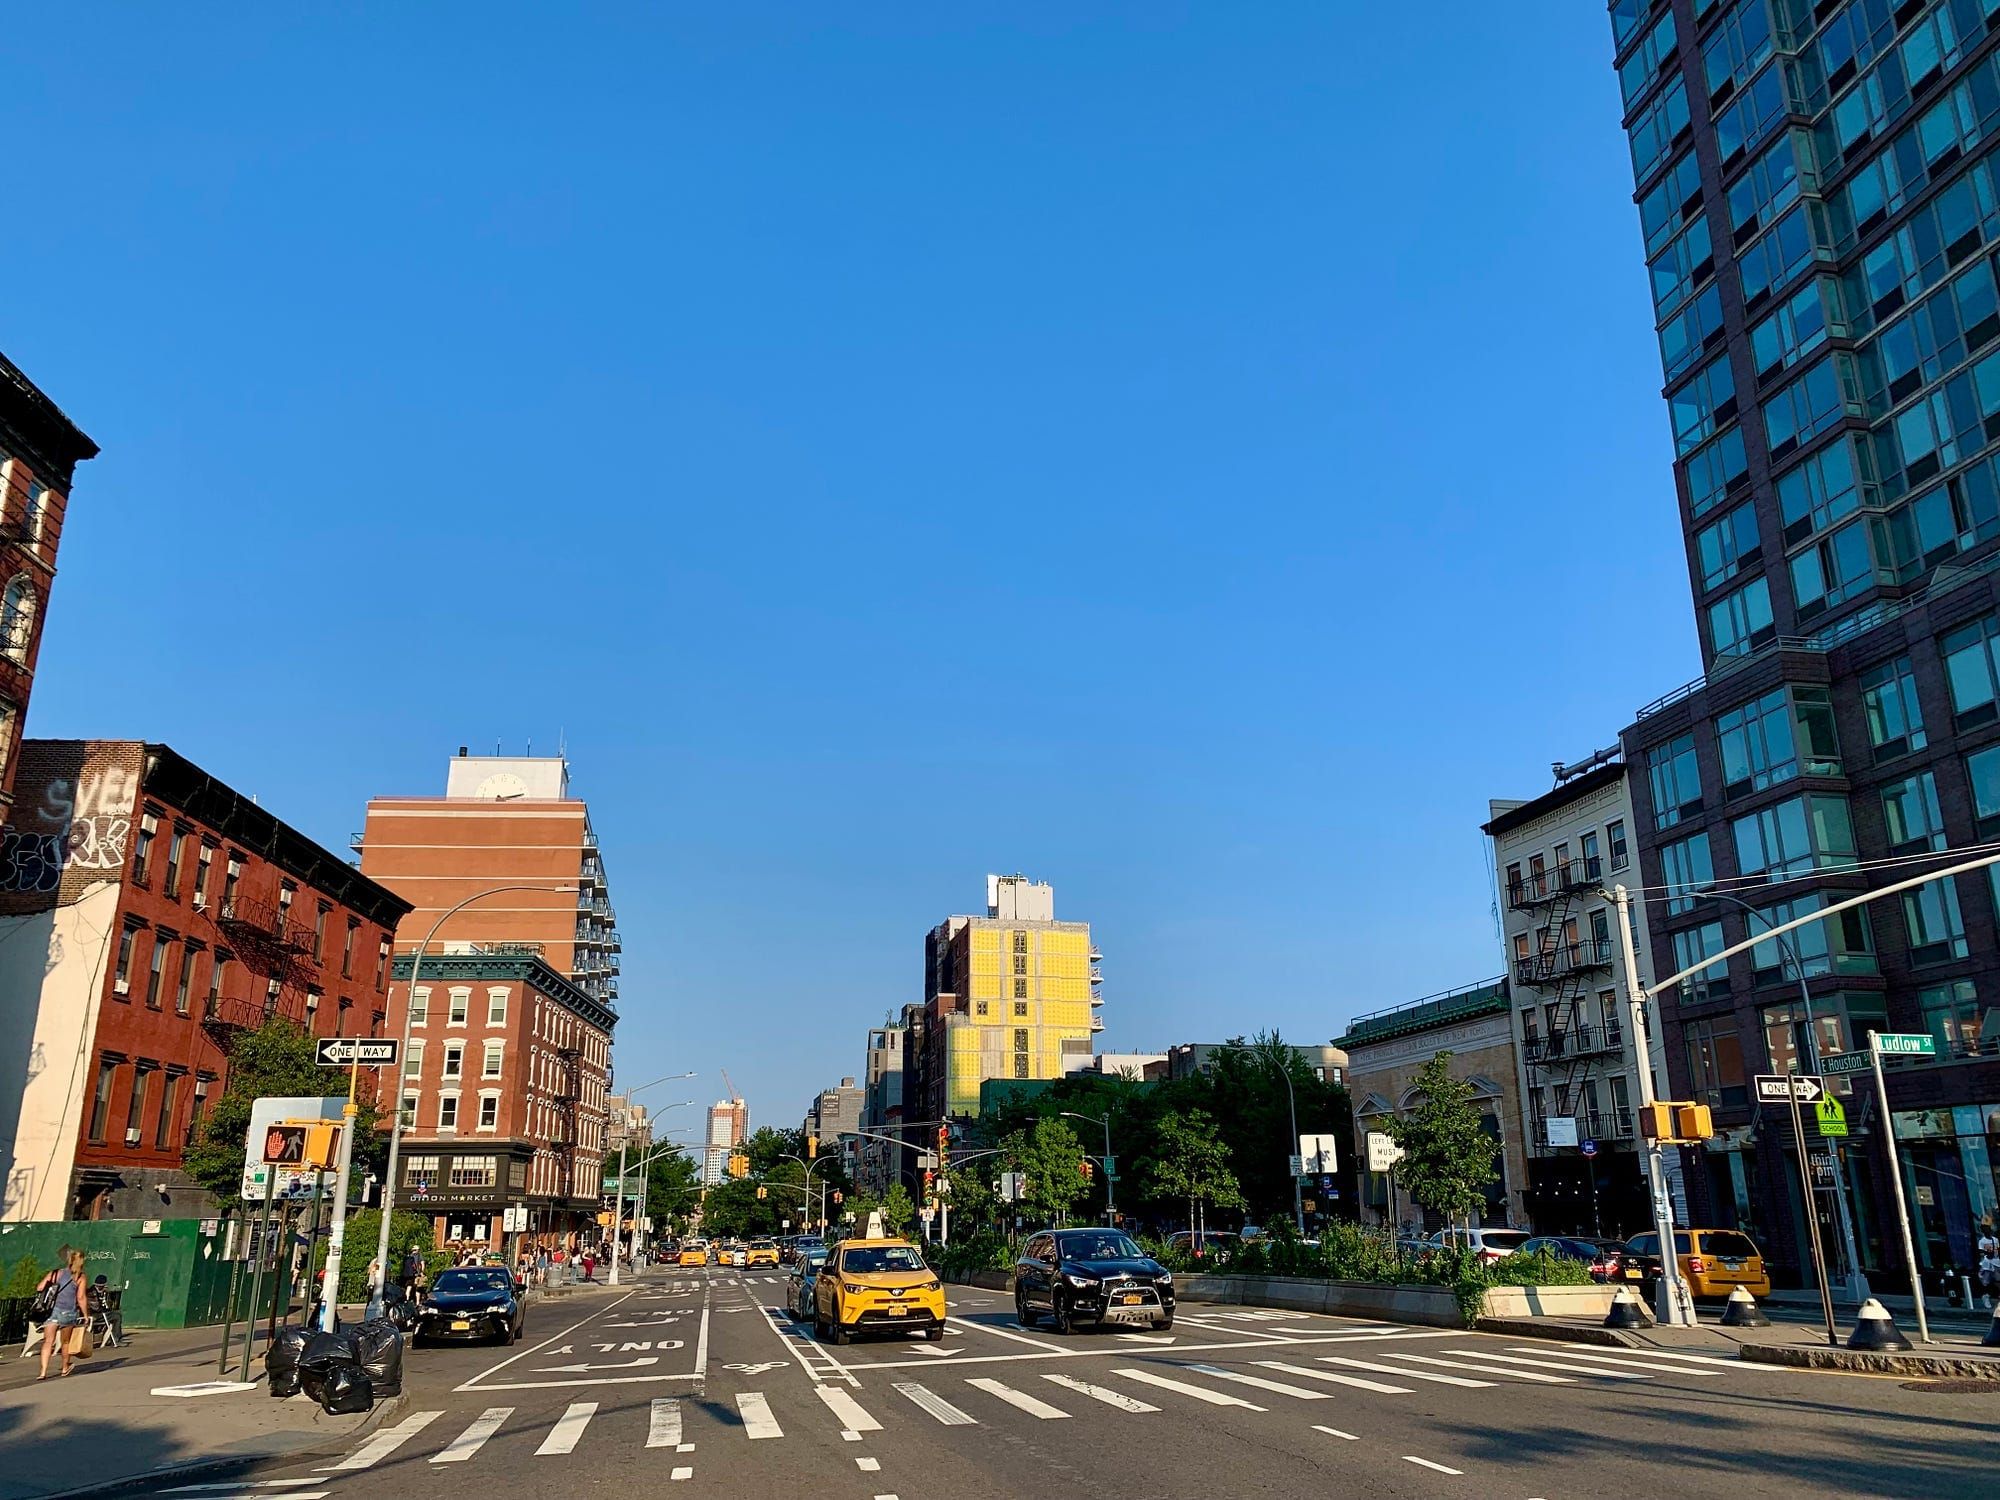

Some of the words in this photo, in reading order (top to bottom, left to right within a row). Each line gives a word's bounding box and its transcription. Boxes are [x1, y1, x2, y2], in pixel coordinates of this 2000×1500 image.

[1880, 1038, 1920, 1051] Ludlow
[330, 1047, 352, 1057] ONE
[363, 1047, 387, 1057] WAY
[1822, 1059, 1827, 1073] E
[1829, 1055, 1862, 1071] Houston
[1767, 1084, 1787, 1094] ONE
[1795, 1085, 1813, 1094] WAY
[1821, 1124, 1846, 1132] SCHOOL
[1377, 1148, 1396, 1156] MUST
[1373, 1159, 1388, 1167] TURN
[450, 1194, 495, 1202] MRKET
[544, 1340, 685, 1354] ONLY
